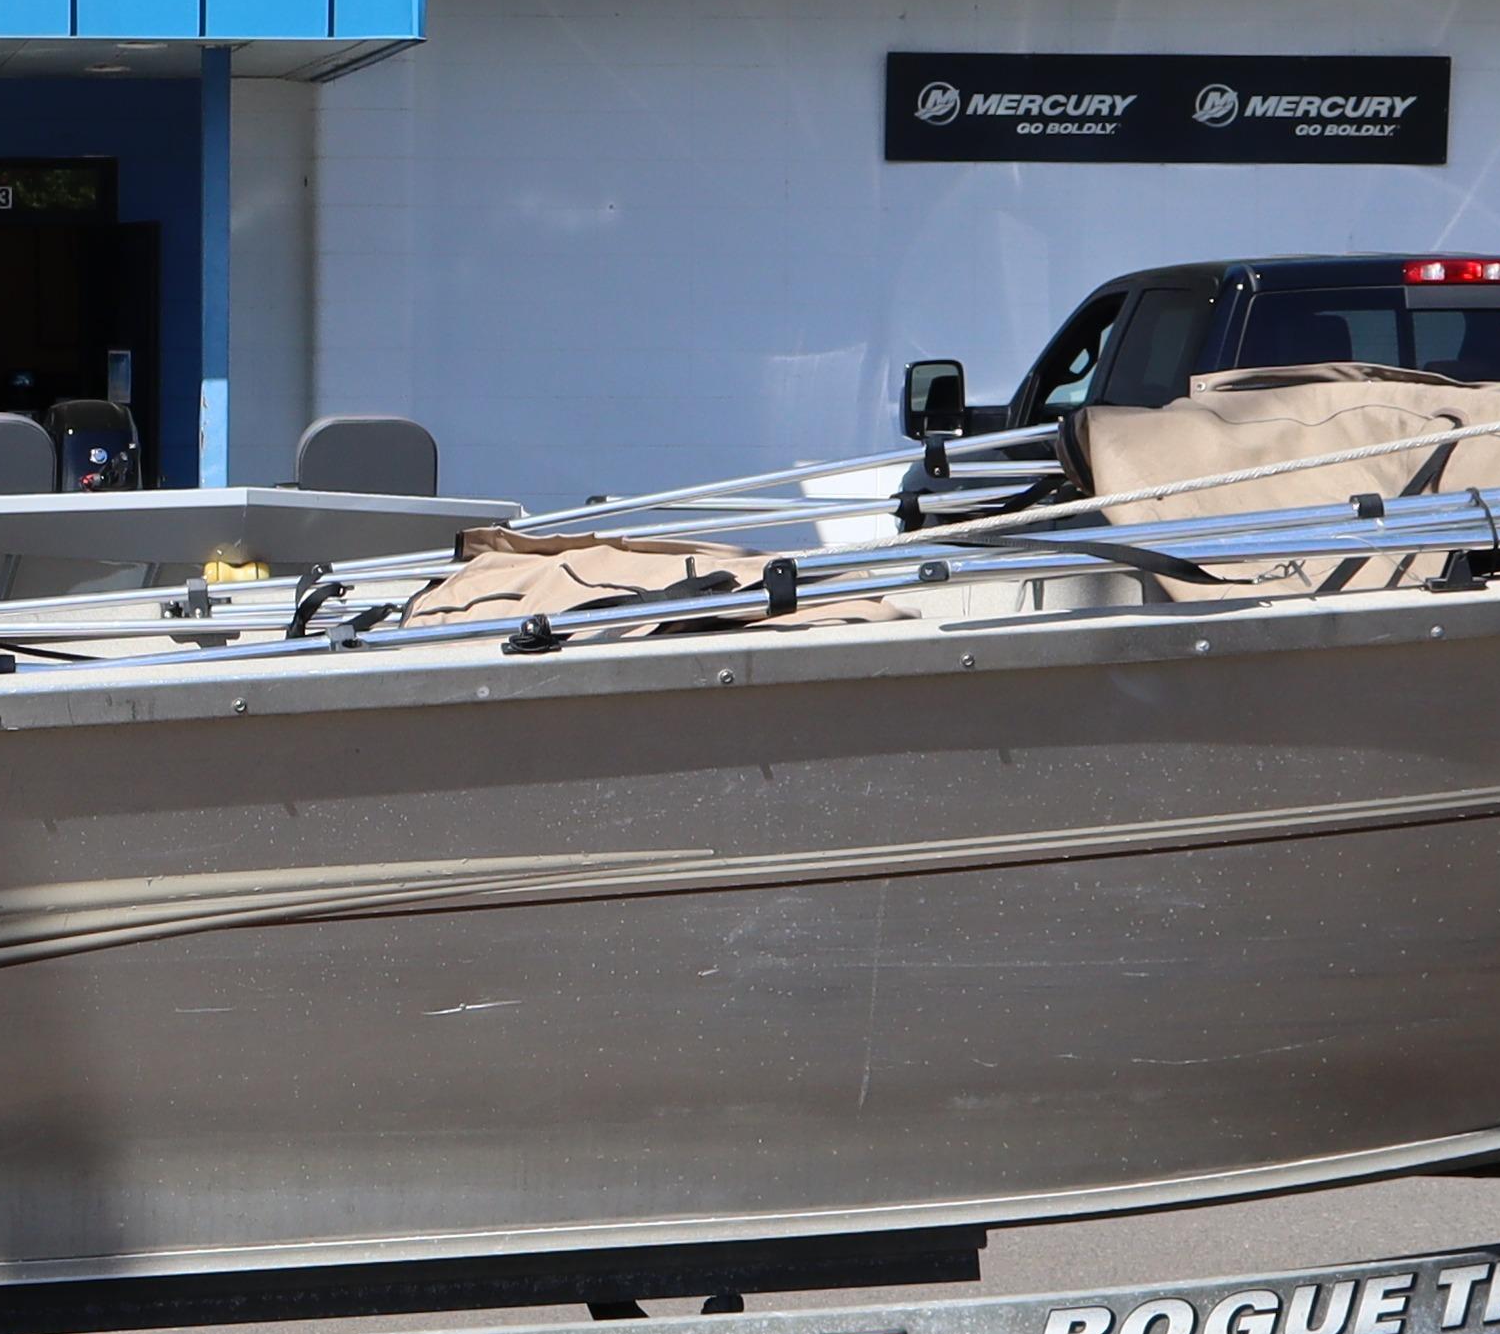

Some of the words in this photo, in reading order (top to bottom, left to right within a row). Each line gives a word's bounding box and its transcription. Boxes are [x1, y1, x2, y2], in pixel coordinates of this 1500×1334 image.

[966, 93, 1138, 117] MERCURY
[1245, 94, 1418, 119] MERCURY
[1016, 122, 1043, 136] GO
[1295, 123, 1322, 137] GO
